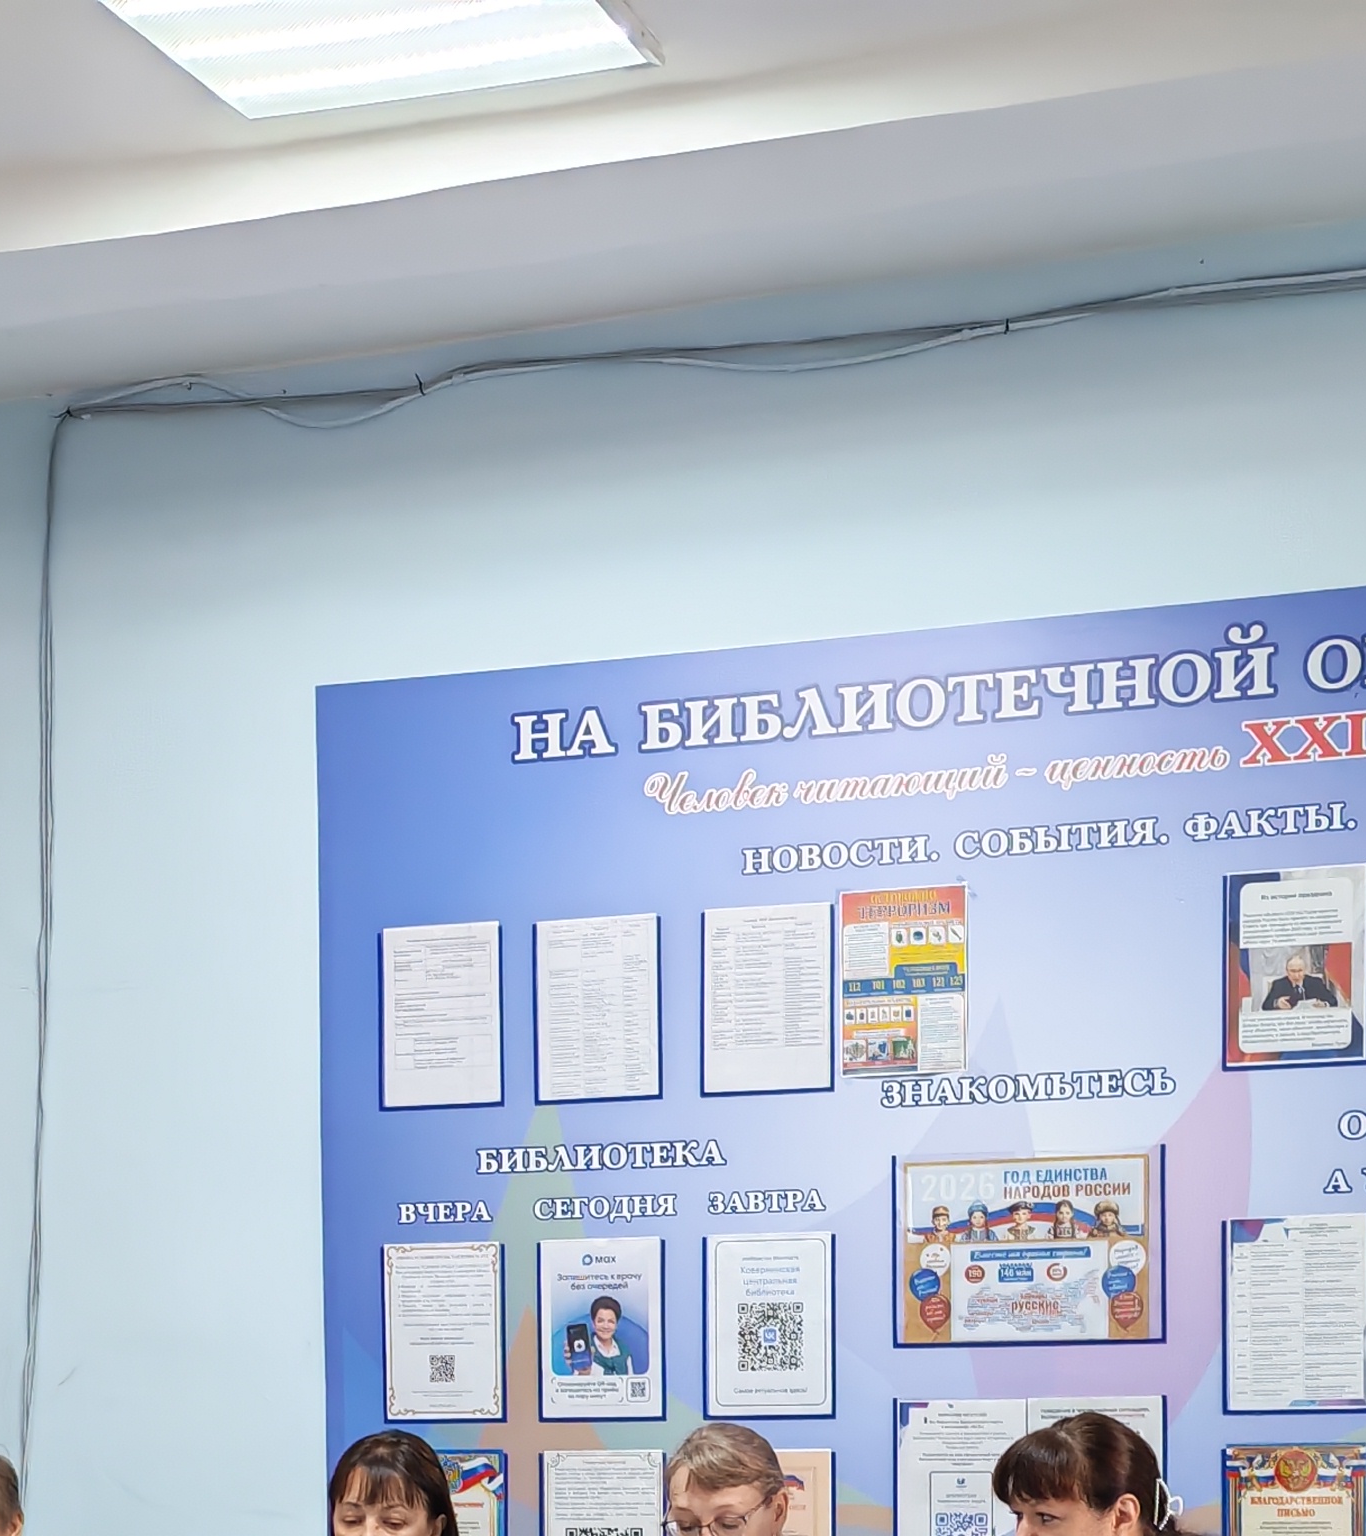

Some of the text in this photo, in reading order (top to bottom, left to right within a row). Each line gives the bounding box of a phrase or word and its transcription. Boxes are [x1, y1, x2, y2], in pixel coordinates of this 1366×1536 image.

[513, 708, 617, 762] НА
[639, 623, 1277, 752] БИБЛИОТЕЧНОЙ
[645, 769, 787, 814] Человек
[795, 754, 1010, 804] читающий
[1044, 746, 1229, 790] ценность
[742, 802, 1357, 876] НОВОСТИ. СОБЫТИЯ. ФАКТЫ.
[880, 1068, 1176, 1109] ЗНАКОМЬТЕСЬ
[476, 1139, 726, 1176] БИБЛИОТЕКА
[921, 1171, 996, 1202] 2026
[1003, 1182, 1132, 1200] НАРОДОВ РОССИИ
[1004, 1167, 1108, 1186] ГОД ЕДИНСТВА
[1323, 1169, 1353, 1194] А
[397, 1199, 493, 1227] ВЧЕРА
[532, 1194, 678, 1223] СЕГОДНЯ
[707, 1189, 827, 1216] ЗАВТРА
[1277, 1508, 1316, 1517] ПИСЬМО
